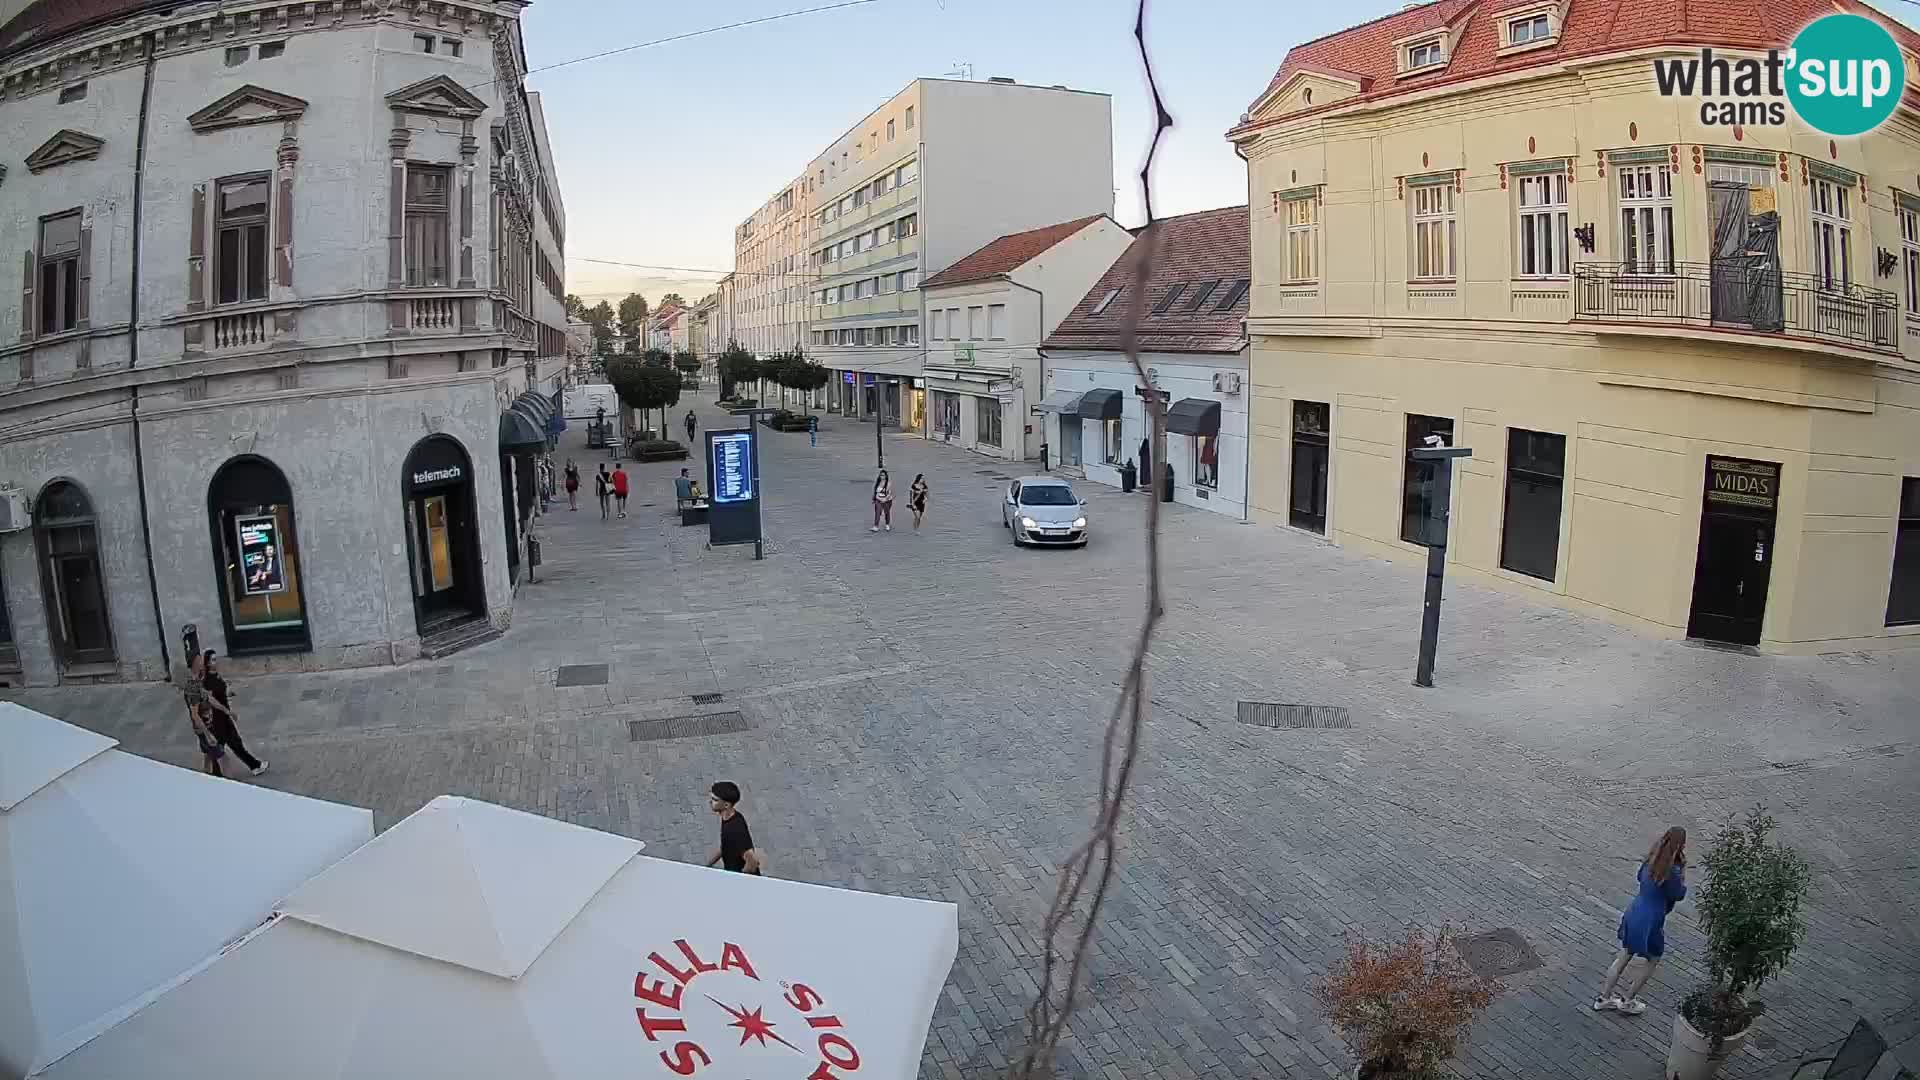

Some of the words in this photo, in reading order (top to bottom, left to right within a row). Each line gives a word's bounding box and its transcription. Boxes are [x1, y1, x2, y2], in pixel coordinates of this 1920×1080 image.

[413, 465, 461, 484] telemach
[1715, 472, 1769, 495] MIDAS
[634, 938, 761, 1075] STELLA
